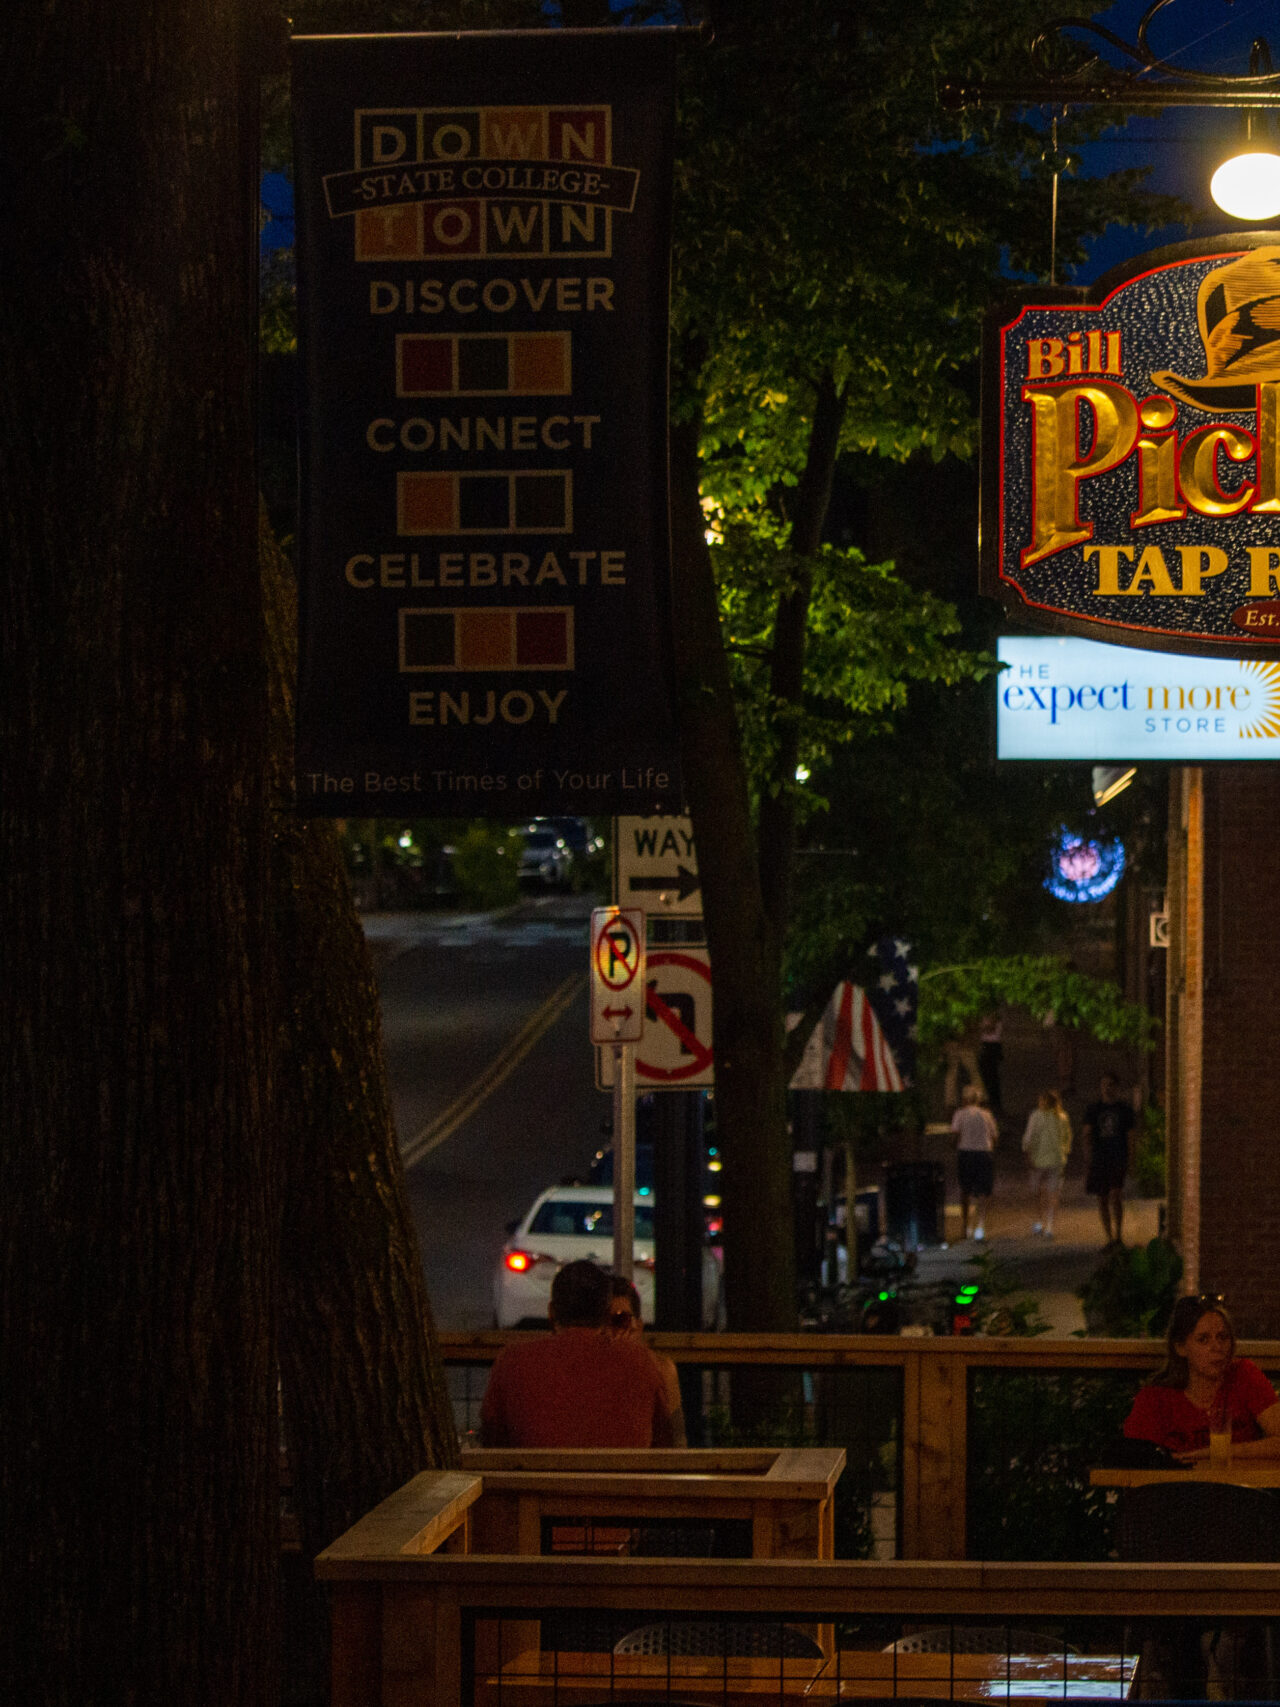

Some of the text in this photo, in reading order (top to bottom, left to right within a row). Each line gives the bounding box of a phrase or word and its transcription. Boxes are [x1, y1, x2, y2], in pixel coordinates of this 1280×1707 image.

[376, 206, 596, 247] TOWN
[369, 277, 615, 315] DISCOVER
[1025, 330, 1124, 379] Bill
[366, 415, 601, 452] CONNECT
[345, 551, 627, 588] CELEBRATE
[1083, 544, 1229, 597] TAP
[409, 689, 568, 725] ENJOY
[1003, 680, 1251, 725] expect more
[1145, 718, 1226, 733] STORE
[307, 767, 670, 793] The Best Times of Your Life
[634, 829, 696, 857] WAY
